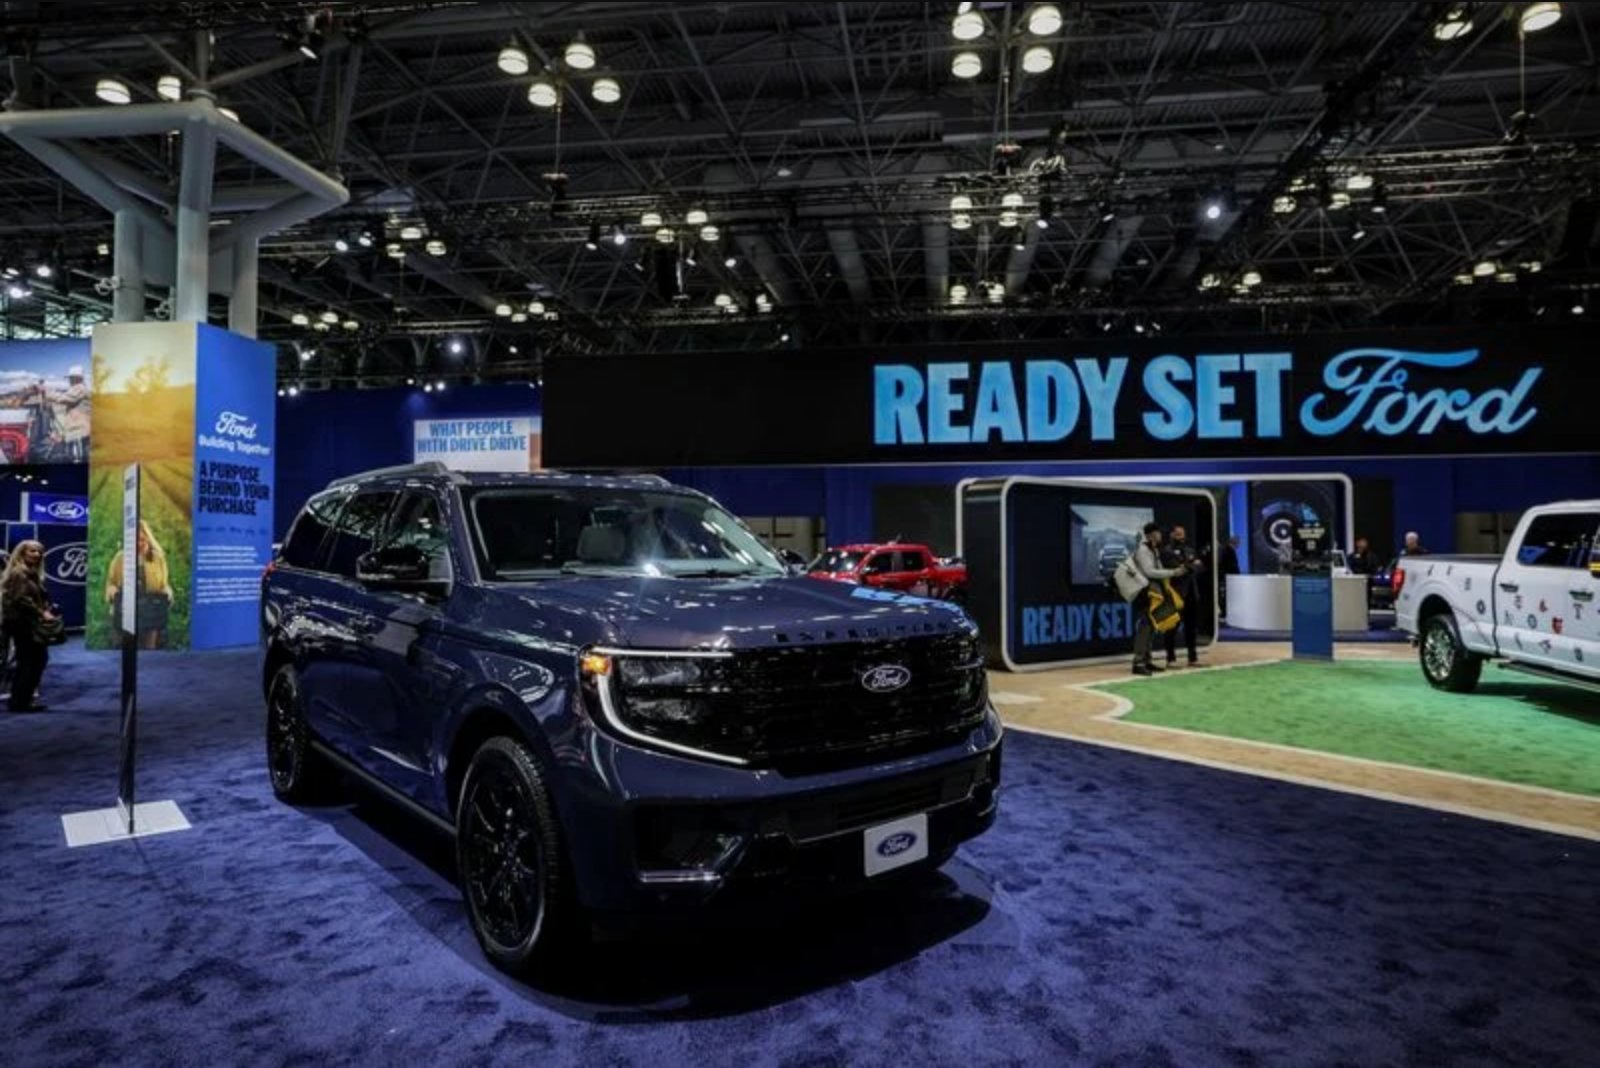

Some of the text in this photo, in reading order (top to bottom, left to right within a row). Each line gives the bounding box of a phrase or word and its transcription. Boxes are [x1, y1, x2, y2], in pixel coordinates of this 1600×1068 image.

[874, 348, 1543, 444] READY SET Ford
[215, 411, 257, 439] Ford
[429, 420, 513, 437] WHAT PEOPLE
[198, 434, 271, 456] Building Together
[416, 435, 527, 453] WITH DRIVE DRIVE
[200, 461, 260, 482] A PURPOSE
[199, 479, 270, 500] BEHIND YOUR
[198, 497, 257, 516] PURCHASE
[57, 547, 88, 577] Fo
[1023, 601, 1132, 645] READY SET
